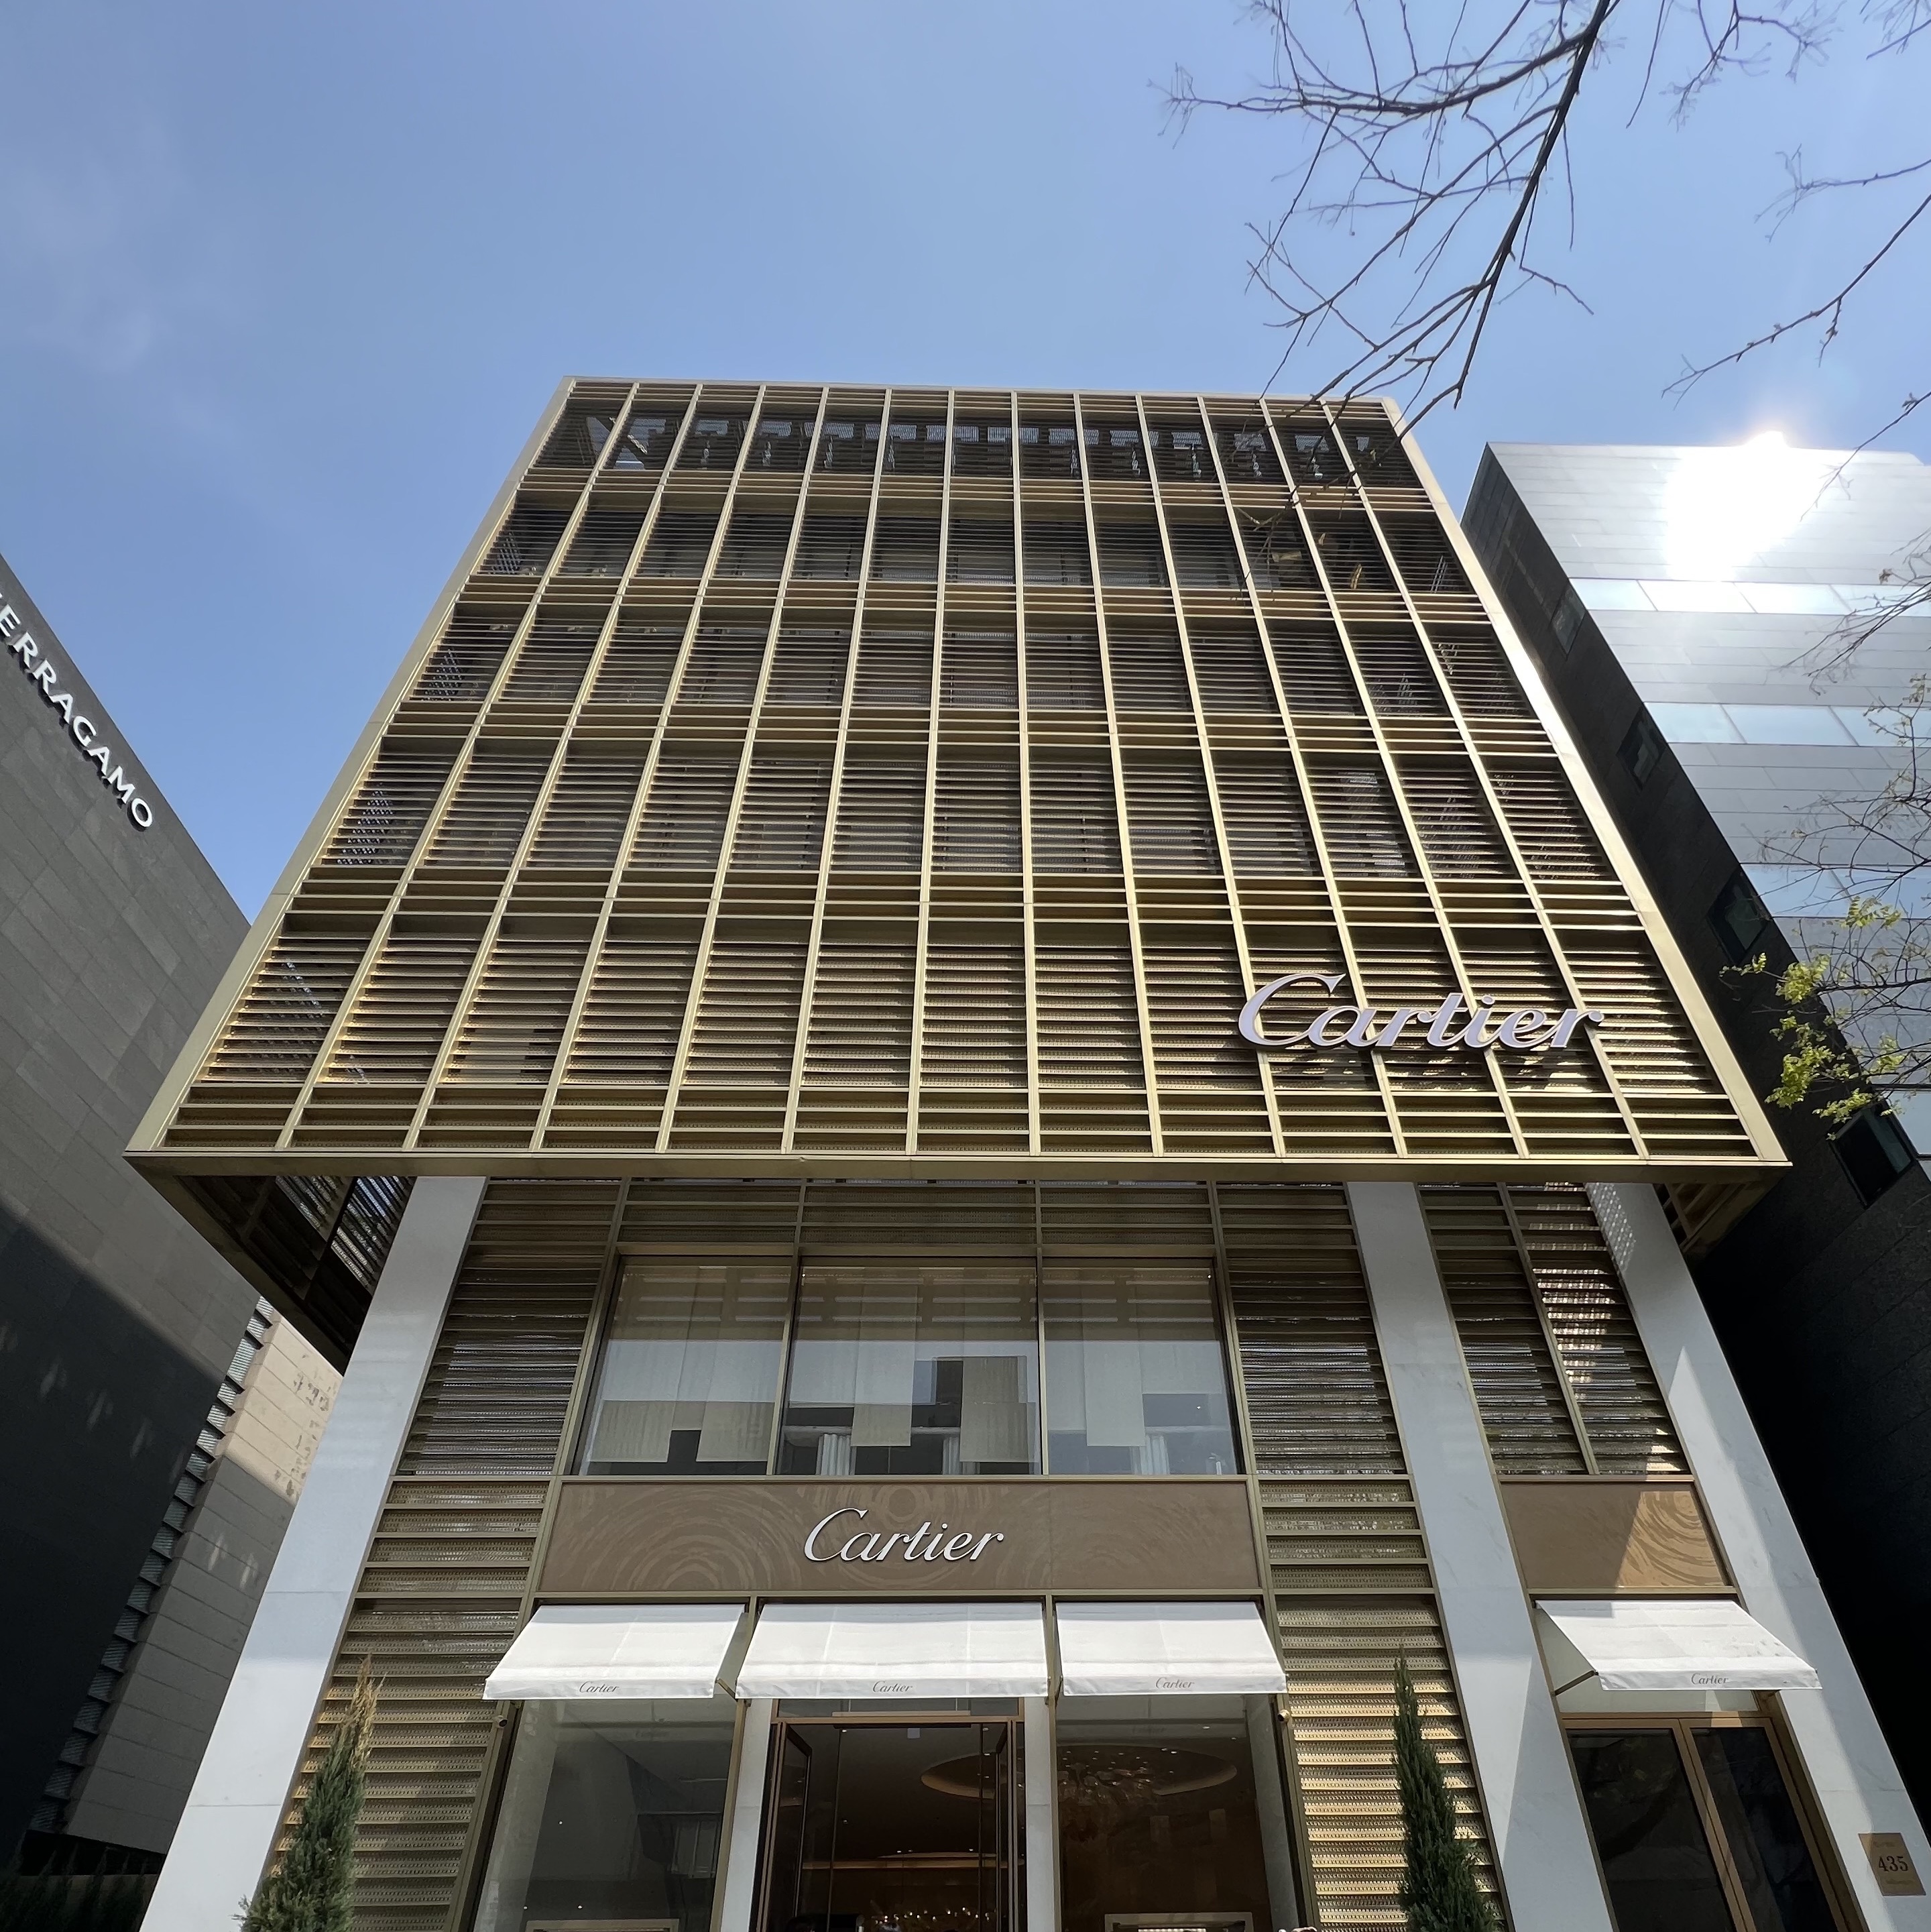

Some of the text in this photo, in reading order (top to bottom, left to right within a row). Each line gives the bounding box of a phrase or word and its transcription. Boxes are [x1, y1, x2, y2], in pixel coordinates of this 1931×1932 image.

[0, 593, 153, 828] ERRAGAMO
[1238, 973, 1604, 1048] Cartier
[804, 1508, 1004, 1562] Cartier
[1155, 1677, 1195, 1689] Cartier
[1691, 1672, 1729, 1685] Cartier
[579, 1681, 620, 1693] Cartier
[872, 1681, 913, 1692] Cartier
[1878, 1856, 1909, 1872] 435
